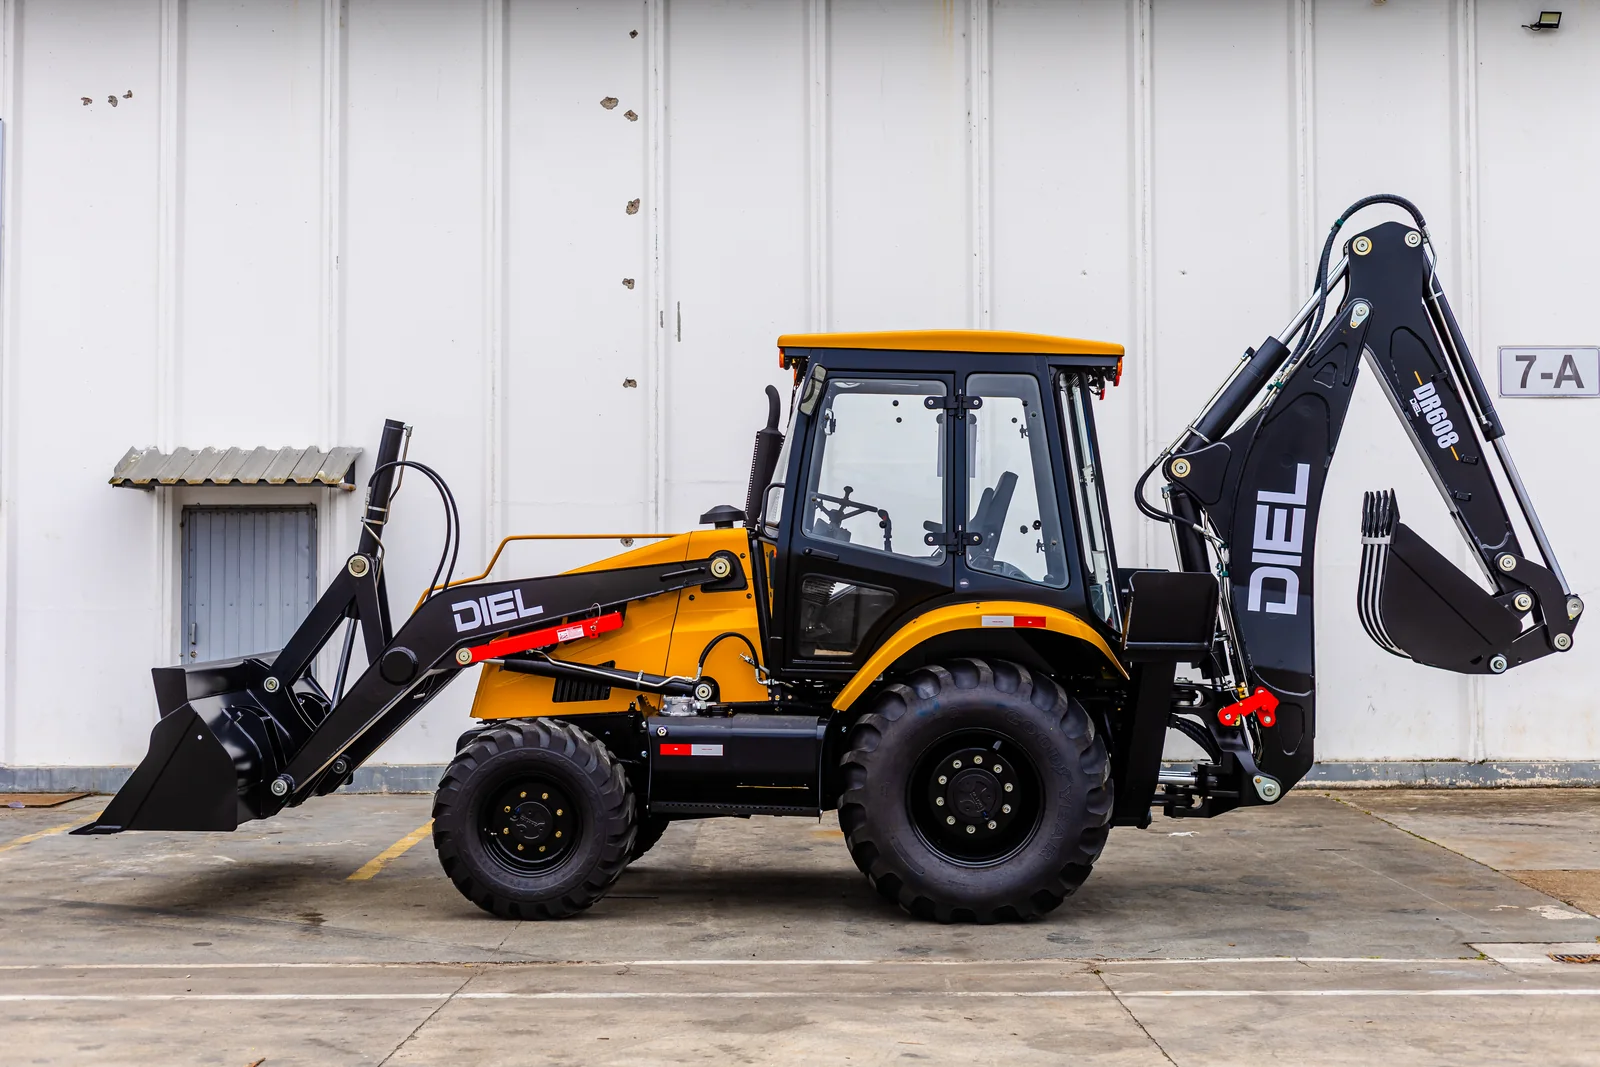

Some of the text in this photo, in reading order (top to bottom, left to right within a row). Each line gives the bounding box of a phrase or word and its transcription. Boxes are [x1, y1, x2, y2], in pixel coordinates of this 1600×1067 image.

[1515, 354, 1585, 389] 7-A
[1409, 397, 1422, 418] DIEL
[1412, 381, 1460, 449] DR608
[1247, 462, 1311, 615] DIEL
[451, 588, 544, 633] DIEL
[1006, 710, 1073, 861] GOODYEAR
